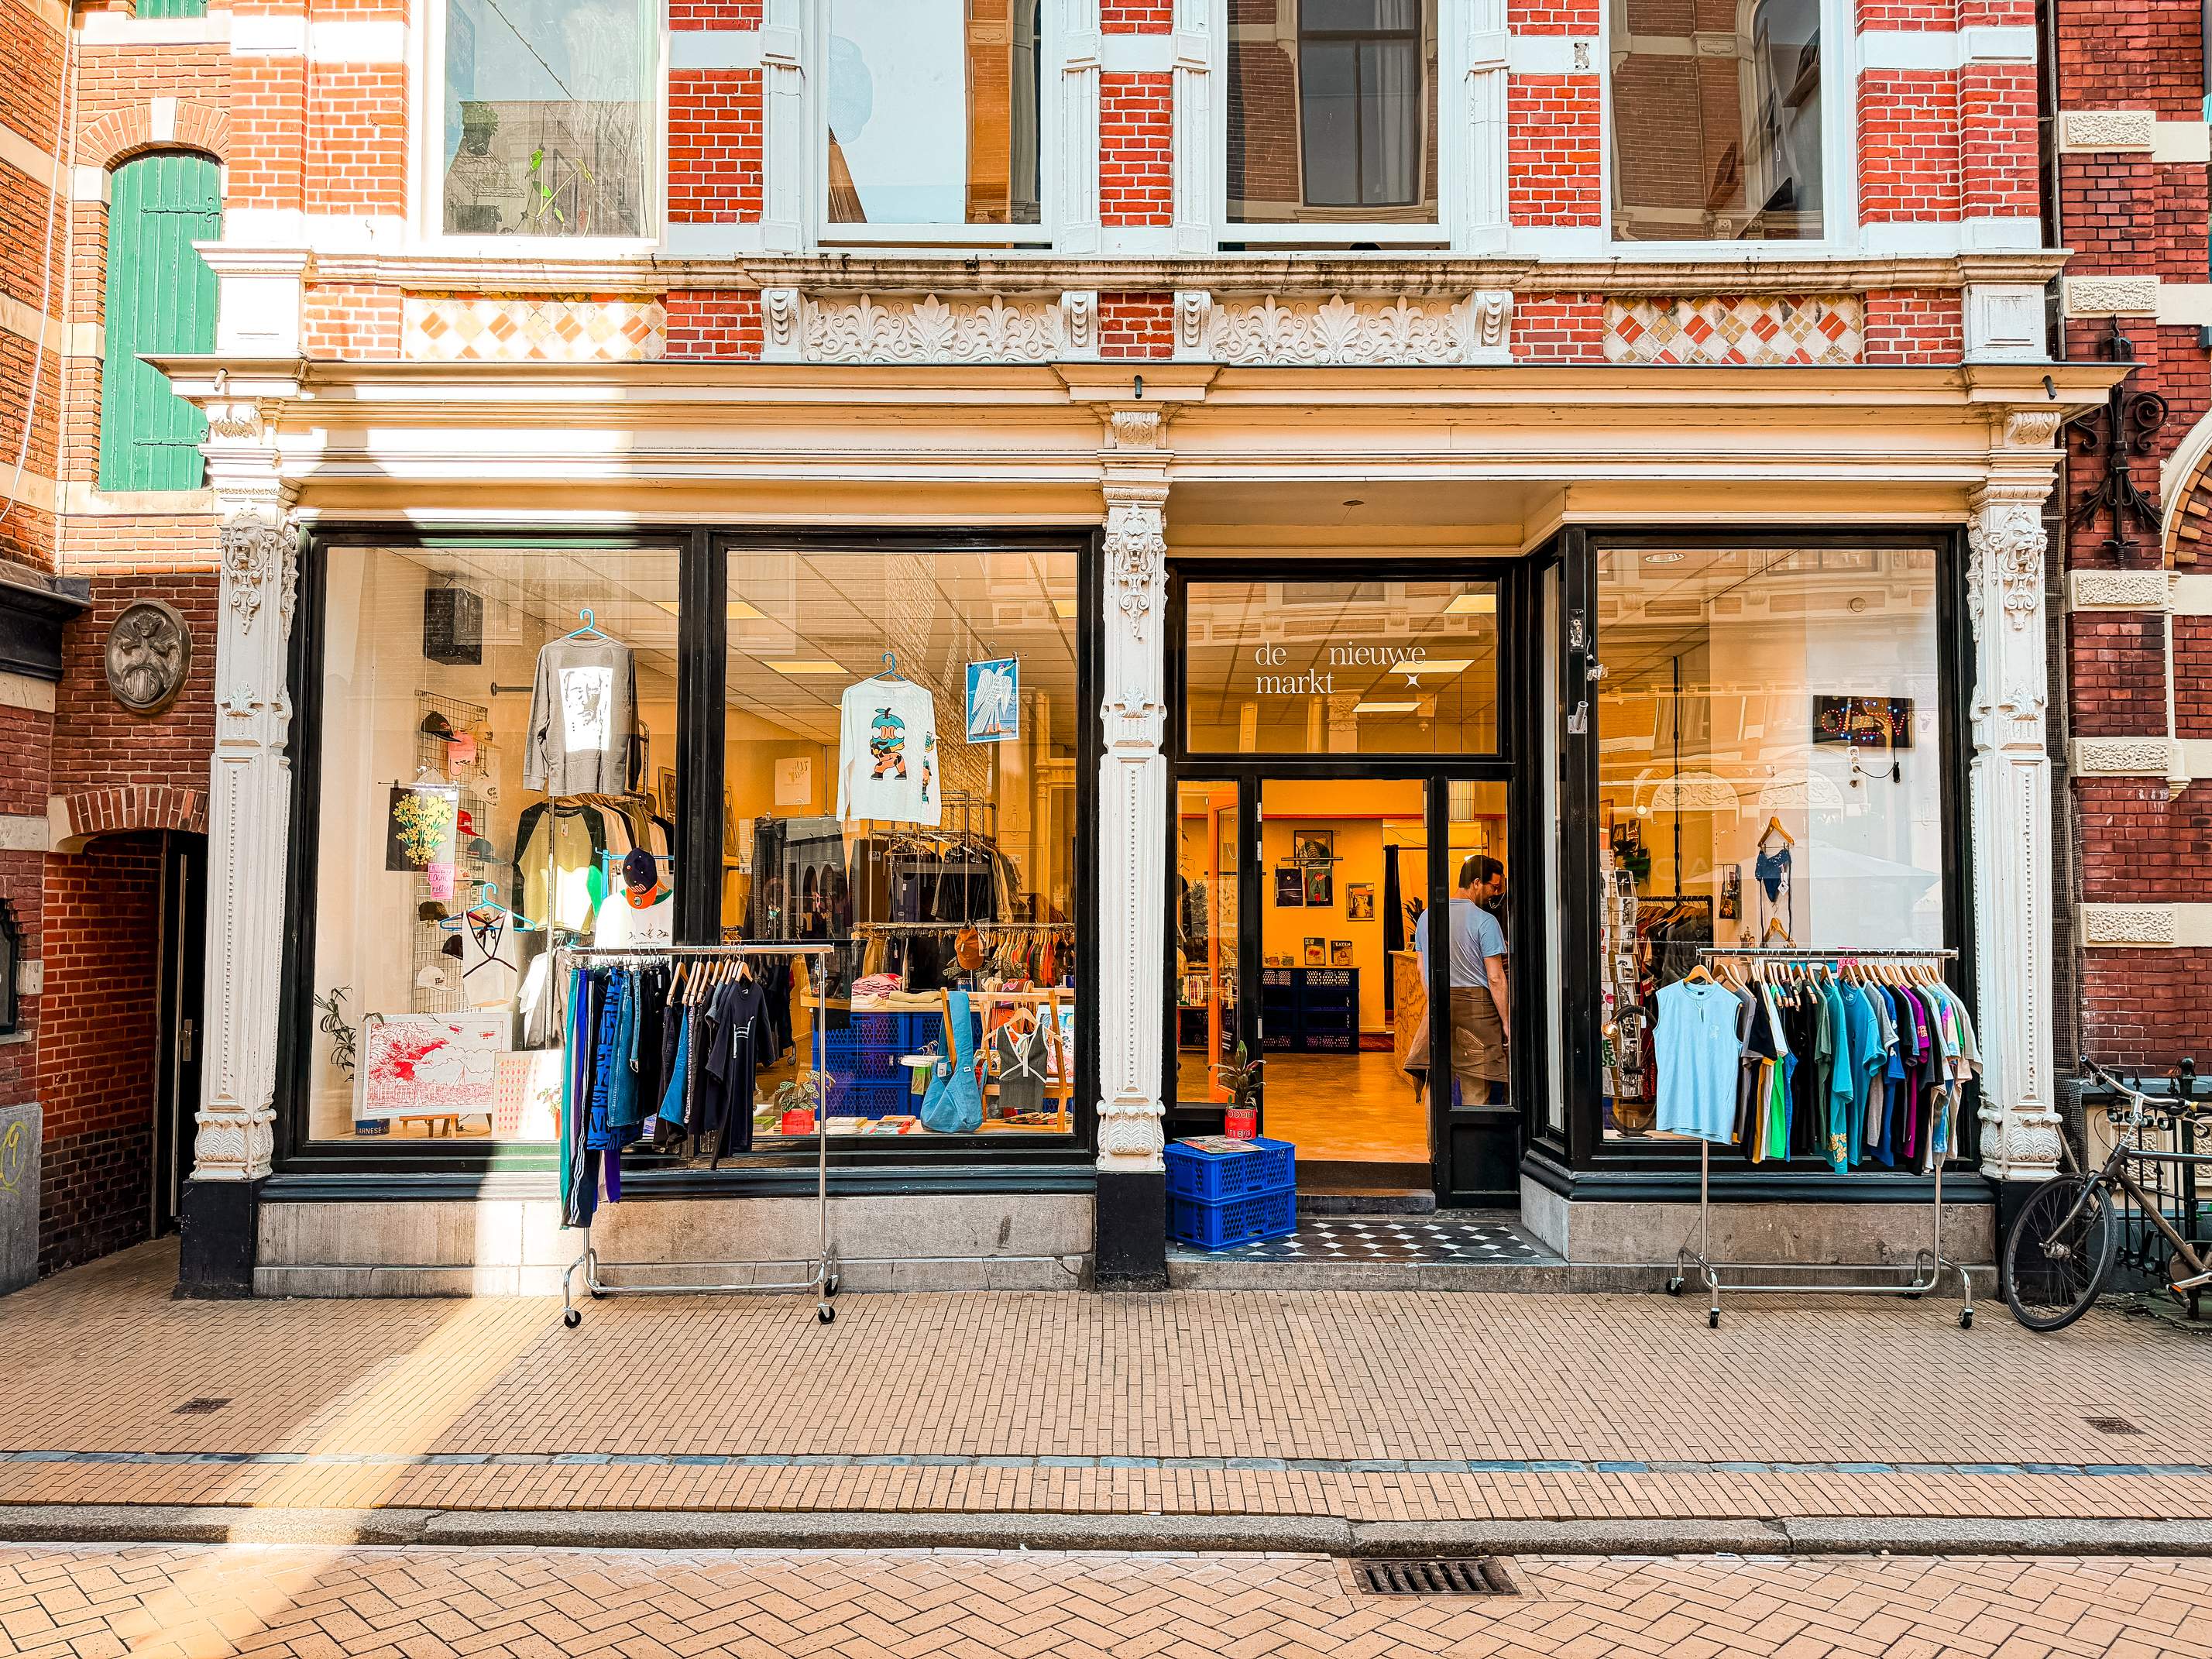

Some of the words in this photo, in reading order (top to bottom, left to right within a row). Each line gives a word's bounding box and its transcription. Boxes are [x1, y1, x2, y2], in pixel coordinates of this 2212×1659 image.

[1255, 641, 1286, 666] de
[1329, 641, 1427, 666] nieuwe
[1255, 668, 1336, 694] markt
